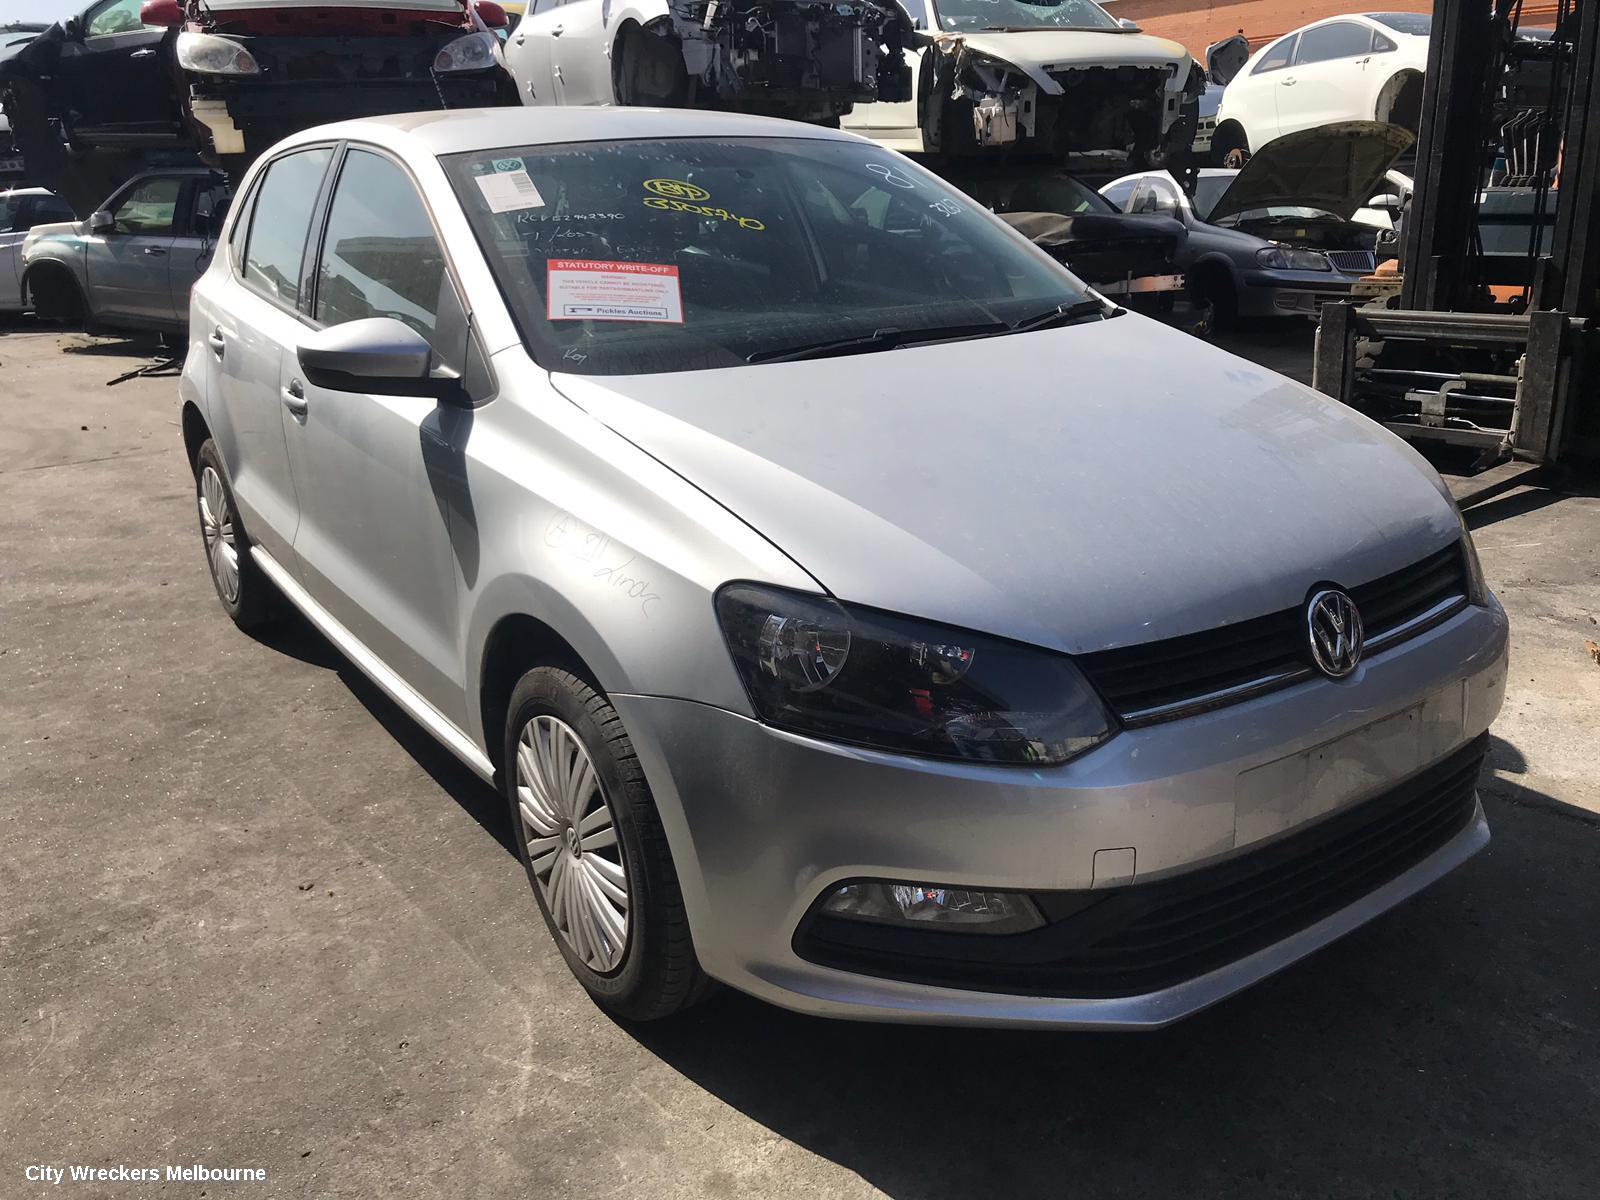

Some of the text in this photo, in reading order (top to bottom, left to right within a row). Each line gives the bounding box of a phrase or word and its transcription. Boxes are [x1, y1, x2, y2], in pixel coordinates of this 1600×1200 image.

[556, 261, 671, 273] STATUTORY WRITE-OFF
[596, 307, 663, 317] Pickles Auctions
